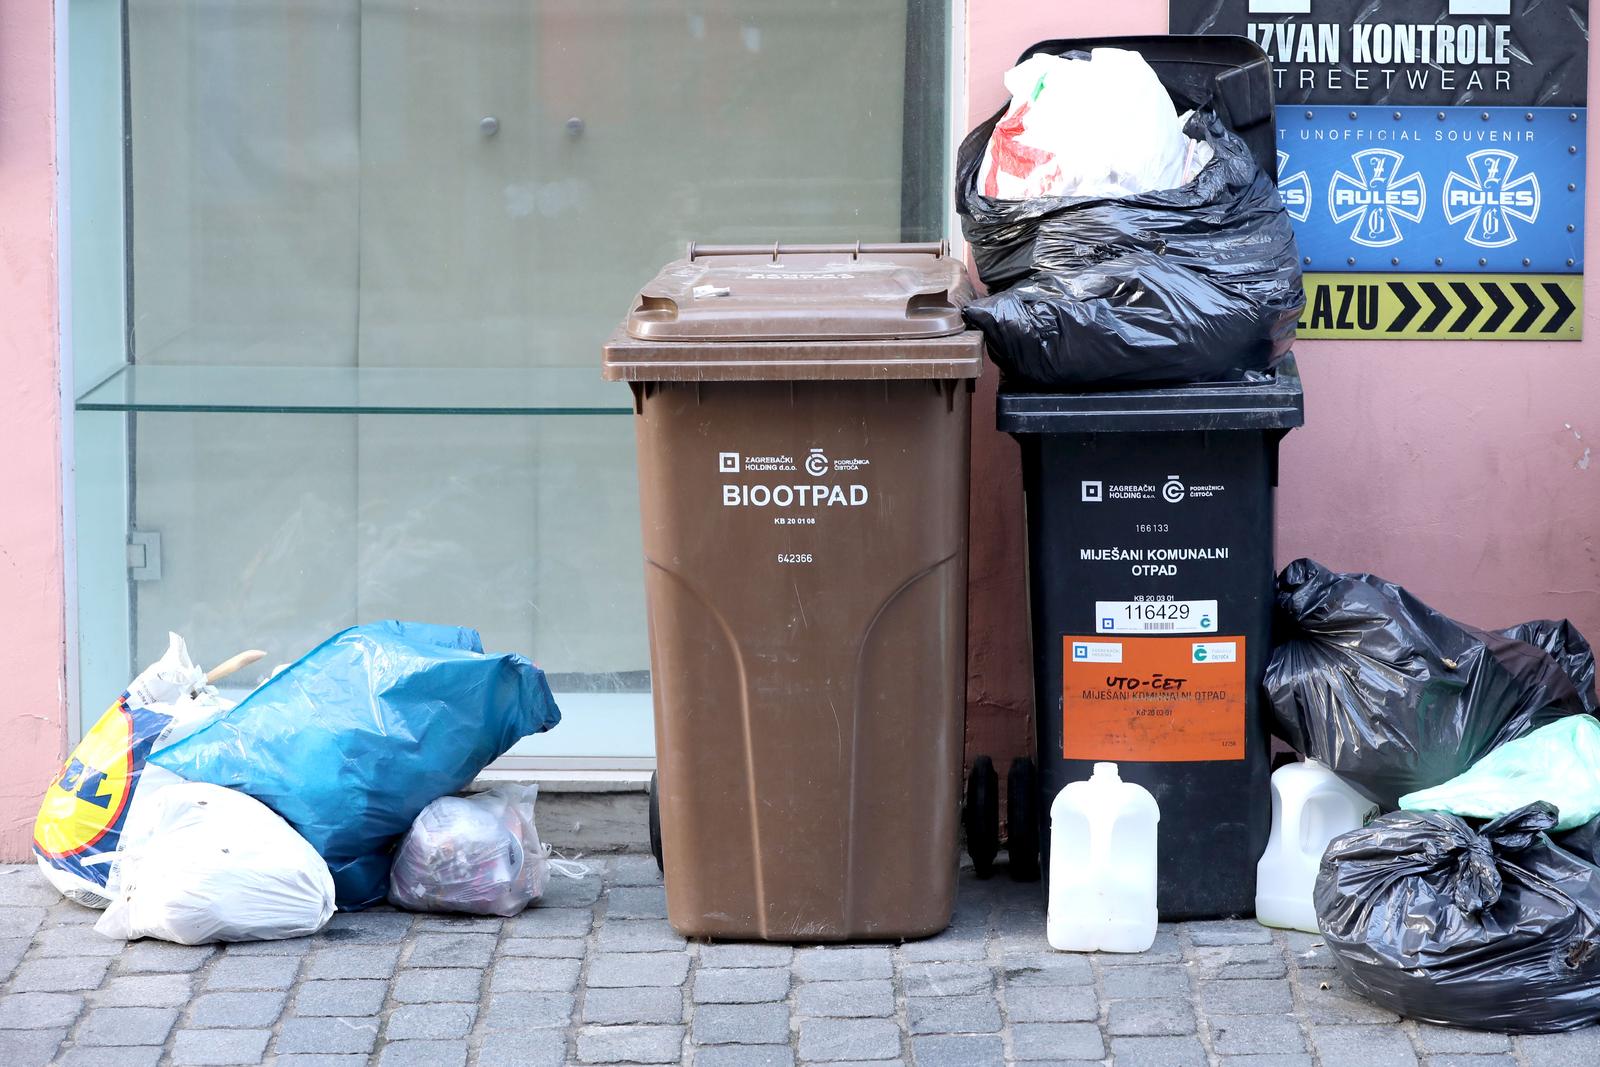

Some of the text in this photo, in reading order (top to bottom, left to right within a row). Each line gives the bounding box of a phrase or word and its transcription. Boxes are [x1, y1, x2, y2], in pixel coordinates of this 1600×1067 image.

[1352, 23, 1511, 65] KONTROLE
[1273, 68, 1511, 91] TREETWEAR
[1300, 128, 1422, 141] UNOFFICIAL
[1434, 130, 1535, 142] SOUVENIR
[1336, 189, 1420, 206] RULES
[1450, 190, 1535, 207] RULES
[1297, 284, 1379, 330] AZU
[745, 455, 793, 464] ZAGREBAČKI
[722, 484, 869, 507] BIOOTPAD
[1109, 484, 1156, 492] ZAGREBAČKI
[777, 553, 813, 563] 642366
[1080, 547, 1229, 561] MIJEŠANI KOMUNALNI
[1131, 564, 1178, 576] OTPAD
[1124, 604, 1190, 620] 116429
[1082, 690, 1130, 701] MIJEŠANI
[1194, 690, 1227, 701] OTPAD
